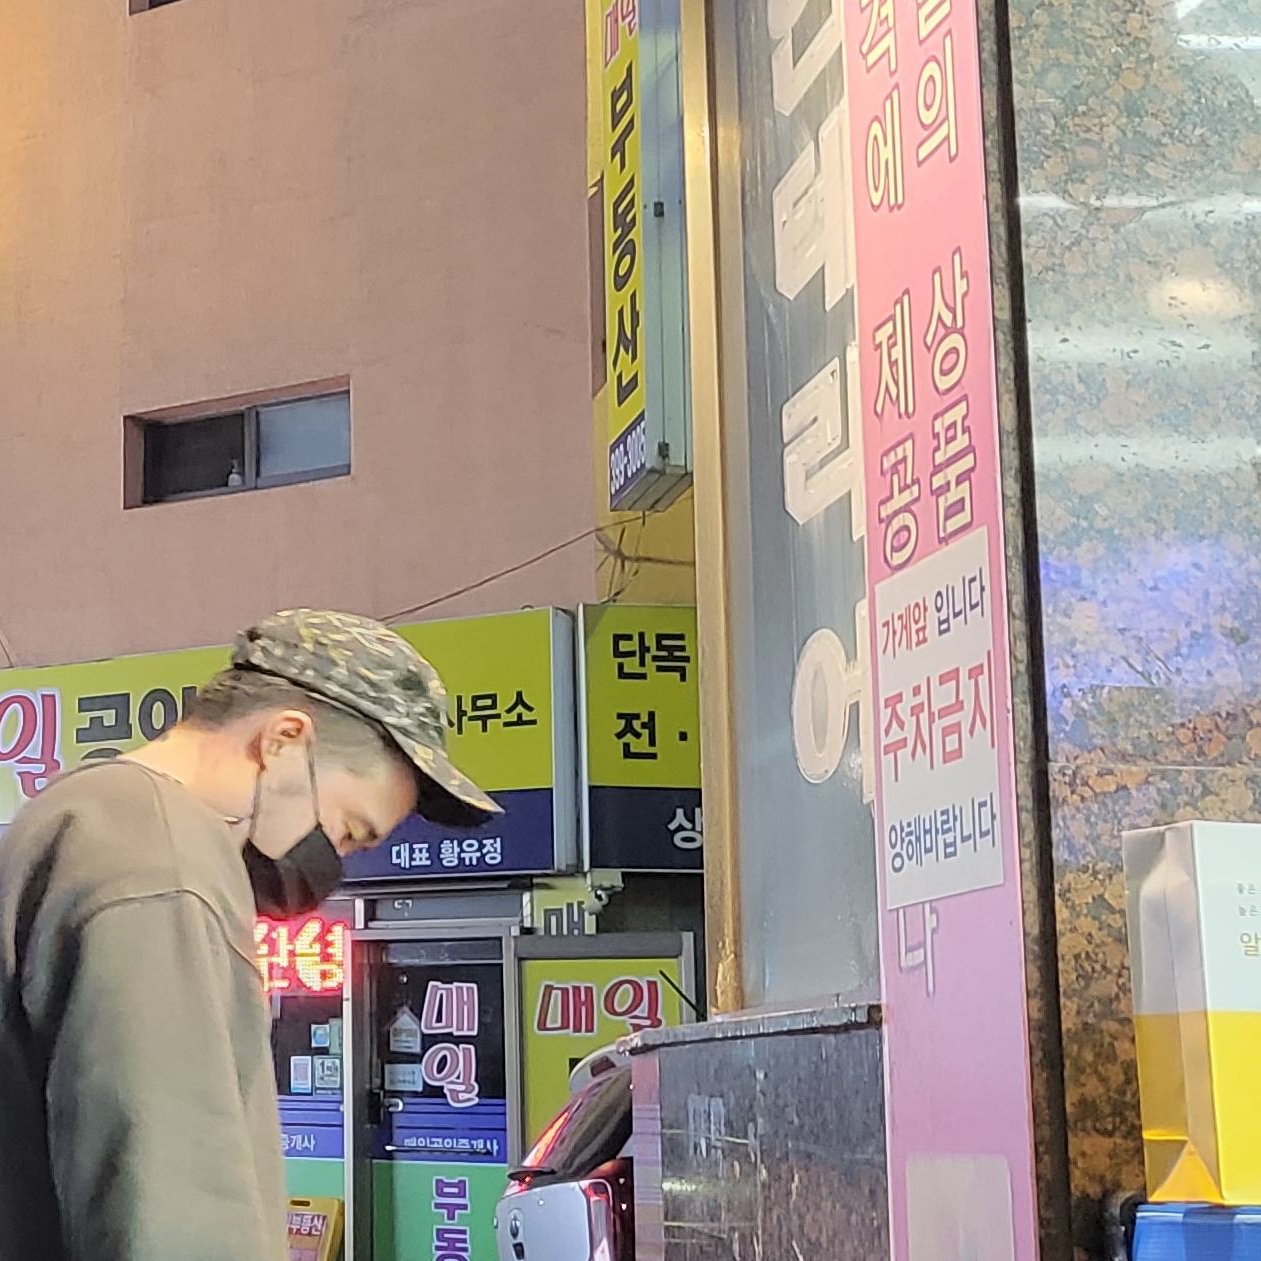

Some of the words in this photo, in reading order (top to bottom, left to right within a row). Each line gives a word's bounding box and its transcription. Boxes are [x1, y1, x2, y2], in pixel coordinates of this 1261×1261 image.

[610, 60, 640, 408] 부동산
[875, 288, 921, 570] 제공
[925, 247, 976, 546] 상품
[612, 631, 691, 683] 단독
[881, 597, 928, 660] 가게앞
[934, 566, 986, 637] 입니다
[882, 649, 997, 783] 주차금지
[391, 842, 432, 870] 대표
[440, 837, 503, 866] 황유정
[888, 792, 997, 874] 양해바랍니다
[420, 980, 480, 1108] 매일
[536, 977, 664, 1034] 매일
